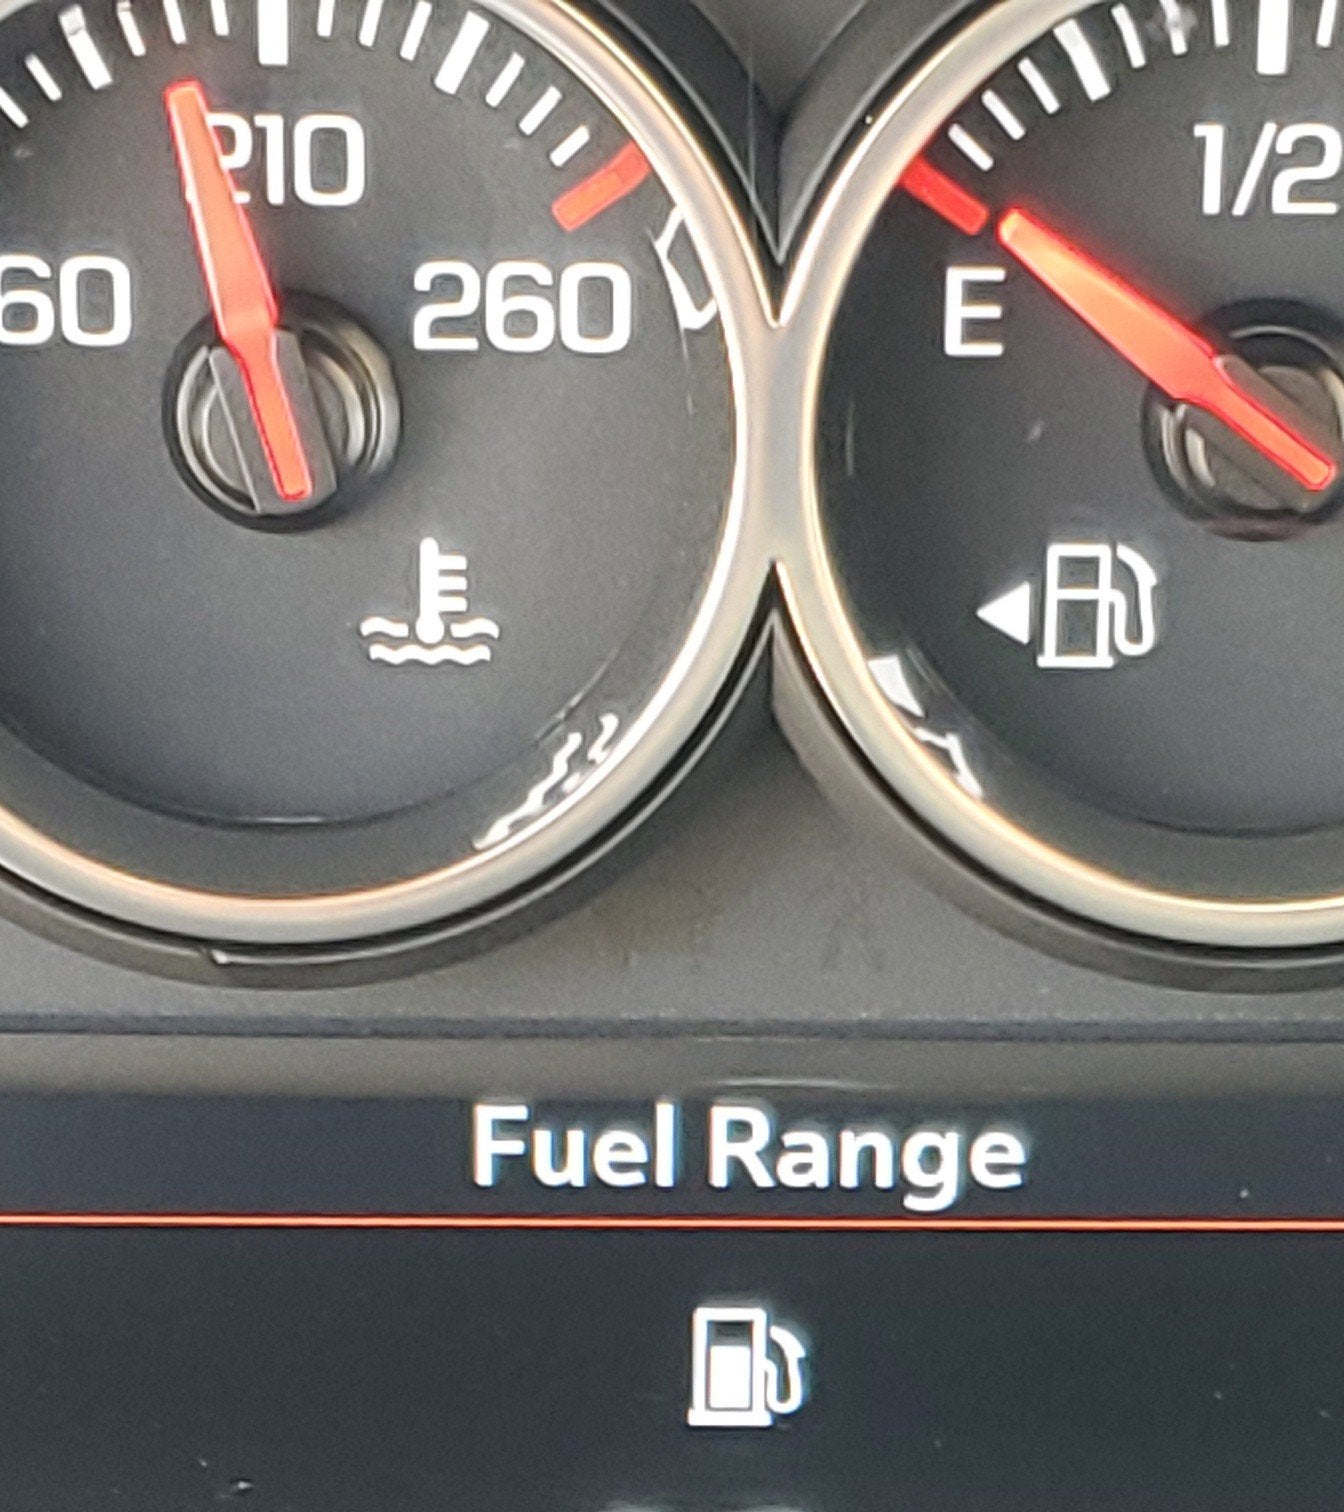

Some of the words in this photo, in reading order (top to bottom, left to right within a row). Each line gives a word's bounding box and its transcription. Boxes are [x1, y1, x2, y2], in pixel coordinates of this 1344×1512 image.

[1194, 120, 1344, 216] 1/2
[412, 259, 633, 355] 260
[944, 266, 1006, 357] E
[473, 1101, 676, 1189] Fuel
[708, 1104, 1027, 1213] Range
